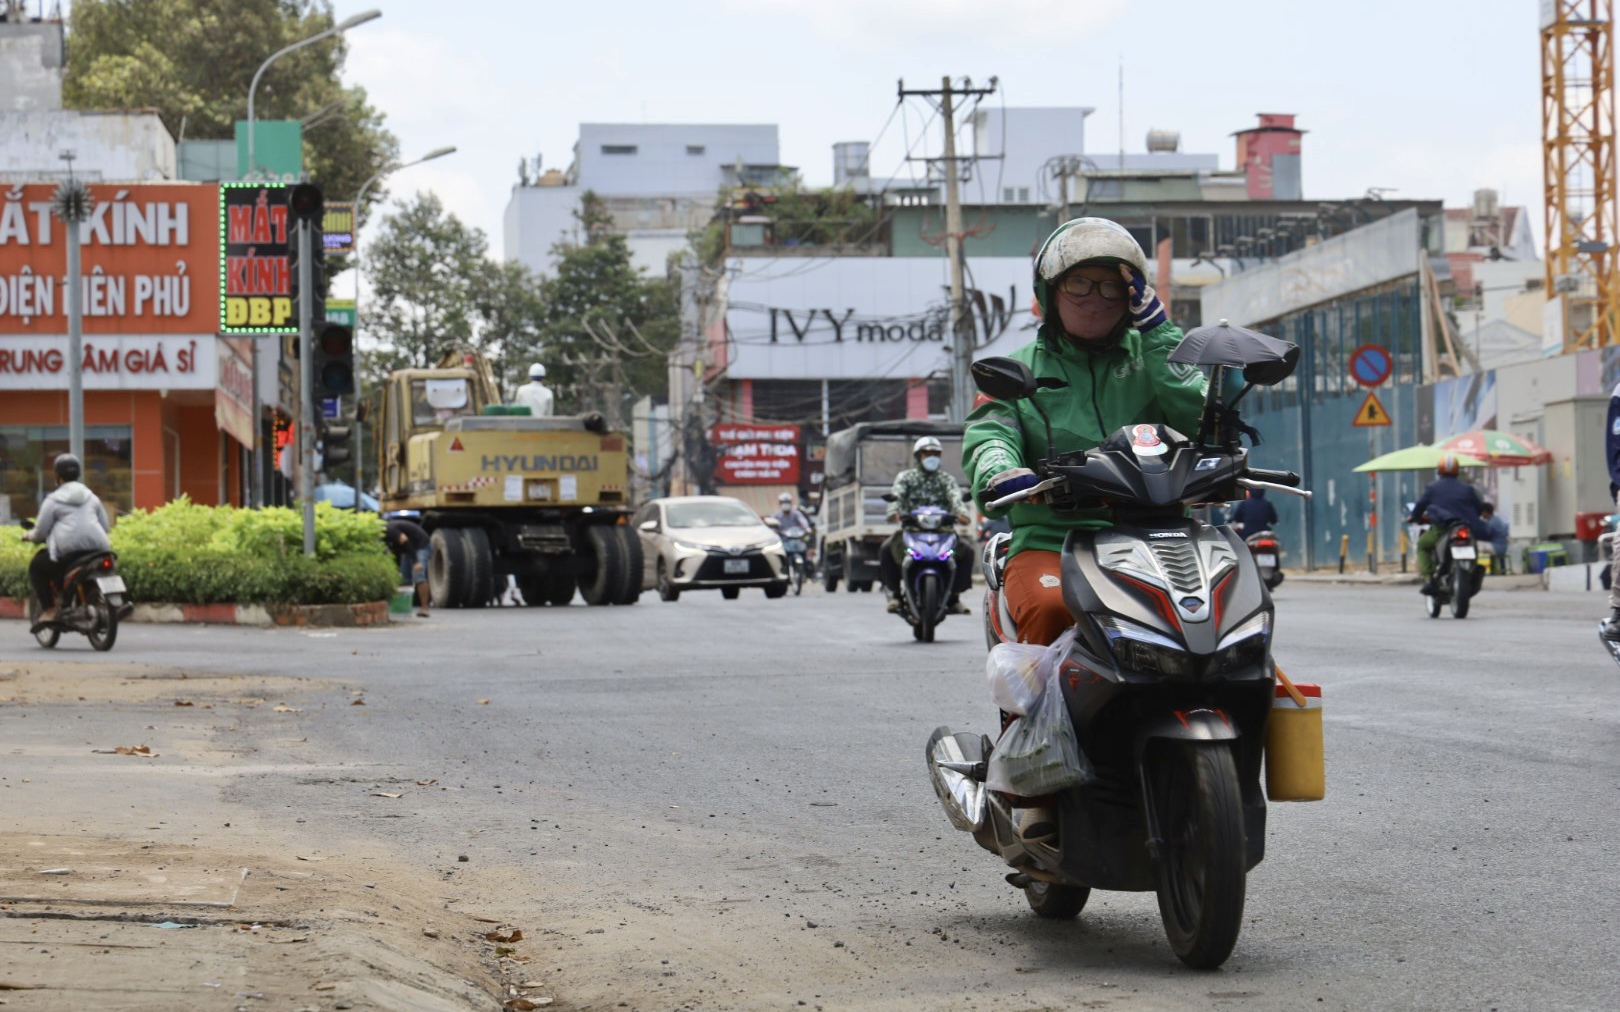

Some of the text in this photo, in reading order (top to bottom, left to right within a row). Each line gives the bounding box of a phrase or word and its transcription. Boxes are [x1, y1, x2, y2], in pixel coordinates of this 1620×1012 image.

[80, 189, 189, 246] KÍNH
[228, 189, 288, 244] MẮT
[62, 264, 126, 317] IÊN
[134, 260, 190, 317] PHỦ
[226, 247, 291, 295] KÍNH
[226, 297, 292, 326] ĐBP
[769, 308, 943, 343] IVY moda
[82, 343, 119, 373] ÂM
[125, 341, 168, 373] GIÁ
[176, 340, 197, 373] SỈ
[481, 455, 598, 472] HYUNDAI
[1148, 531, 1188, 539] HONDA
